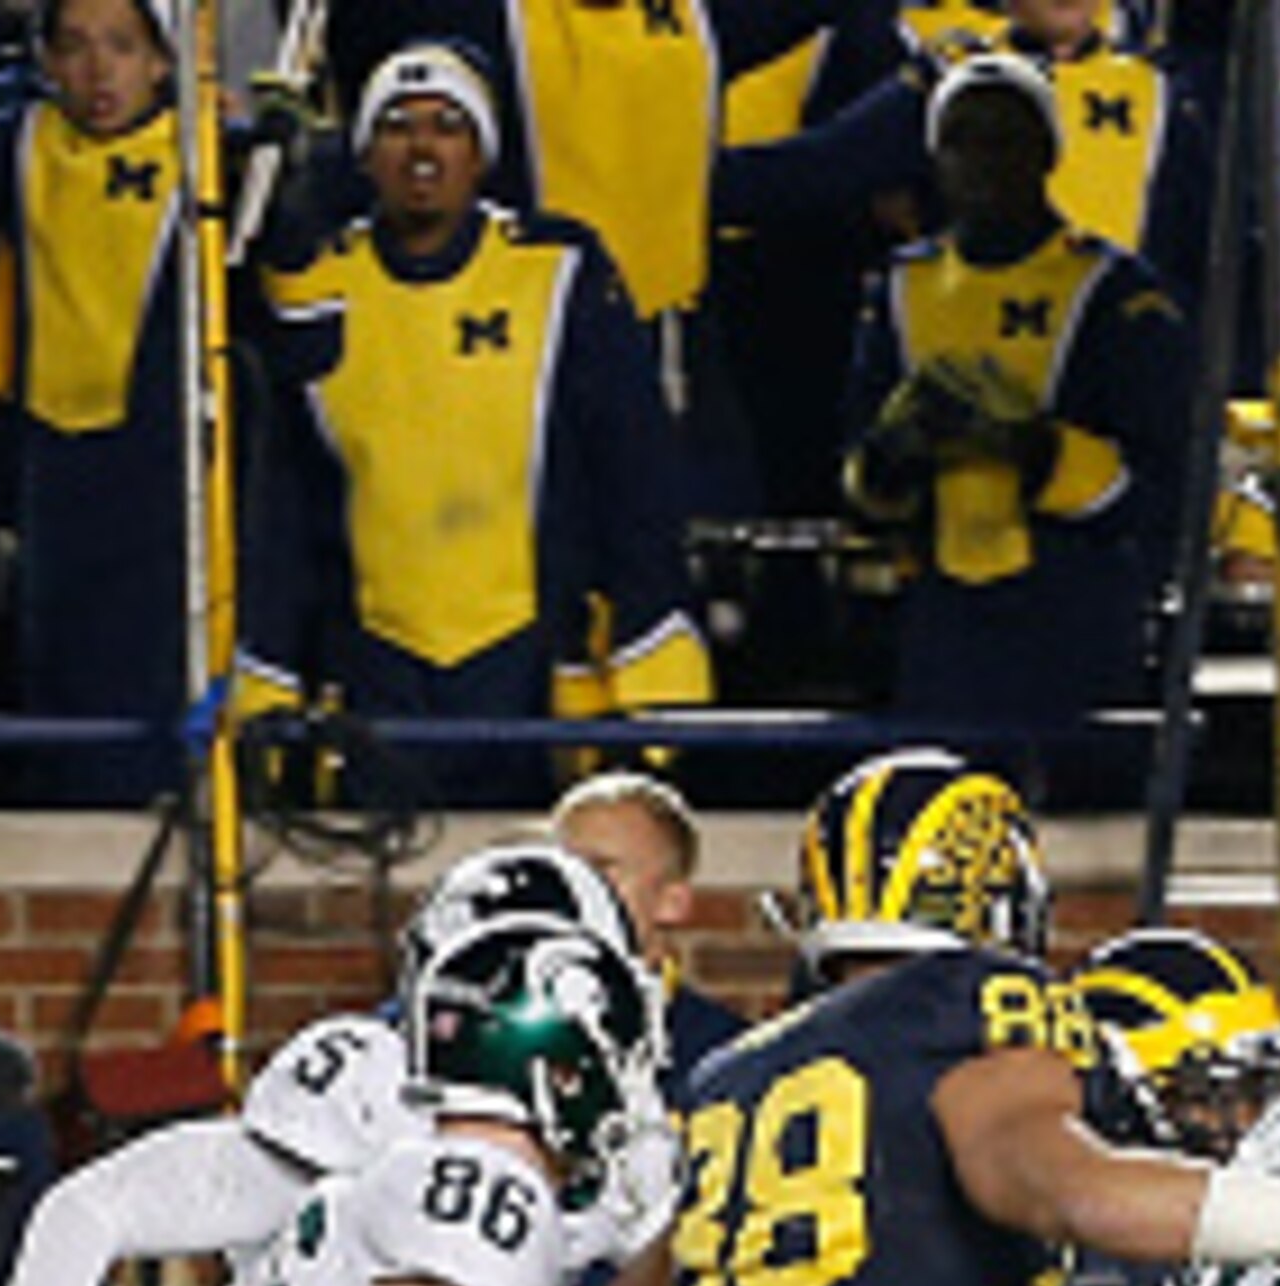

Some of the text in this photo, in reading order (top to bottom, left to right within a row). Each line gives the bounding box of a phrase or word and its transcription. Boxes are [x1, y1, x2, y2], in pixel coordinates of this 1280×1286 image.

[1081, 90, 1135, 137] M
[105, 154, 161, 201] M
[453, 309, 512, 357] M
[999, 297, 1054, 339] M
[295, 1029, 372, 1098] 5
[423, 1157, 537, 1254] 86
